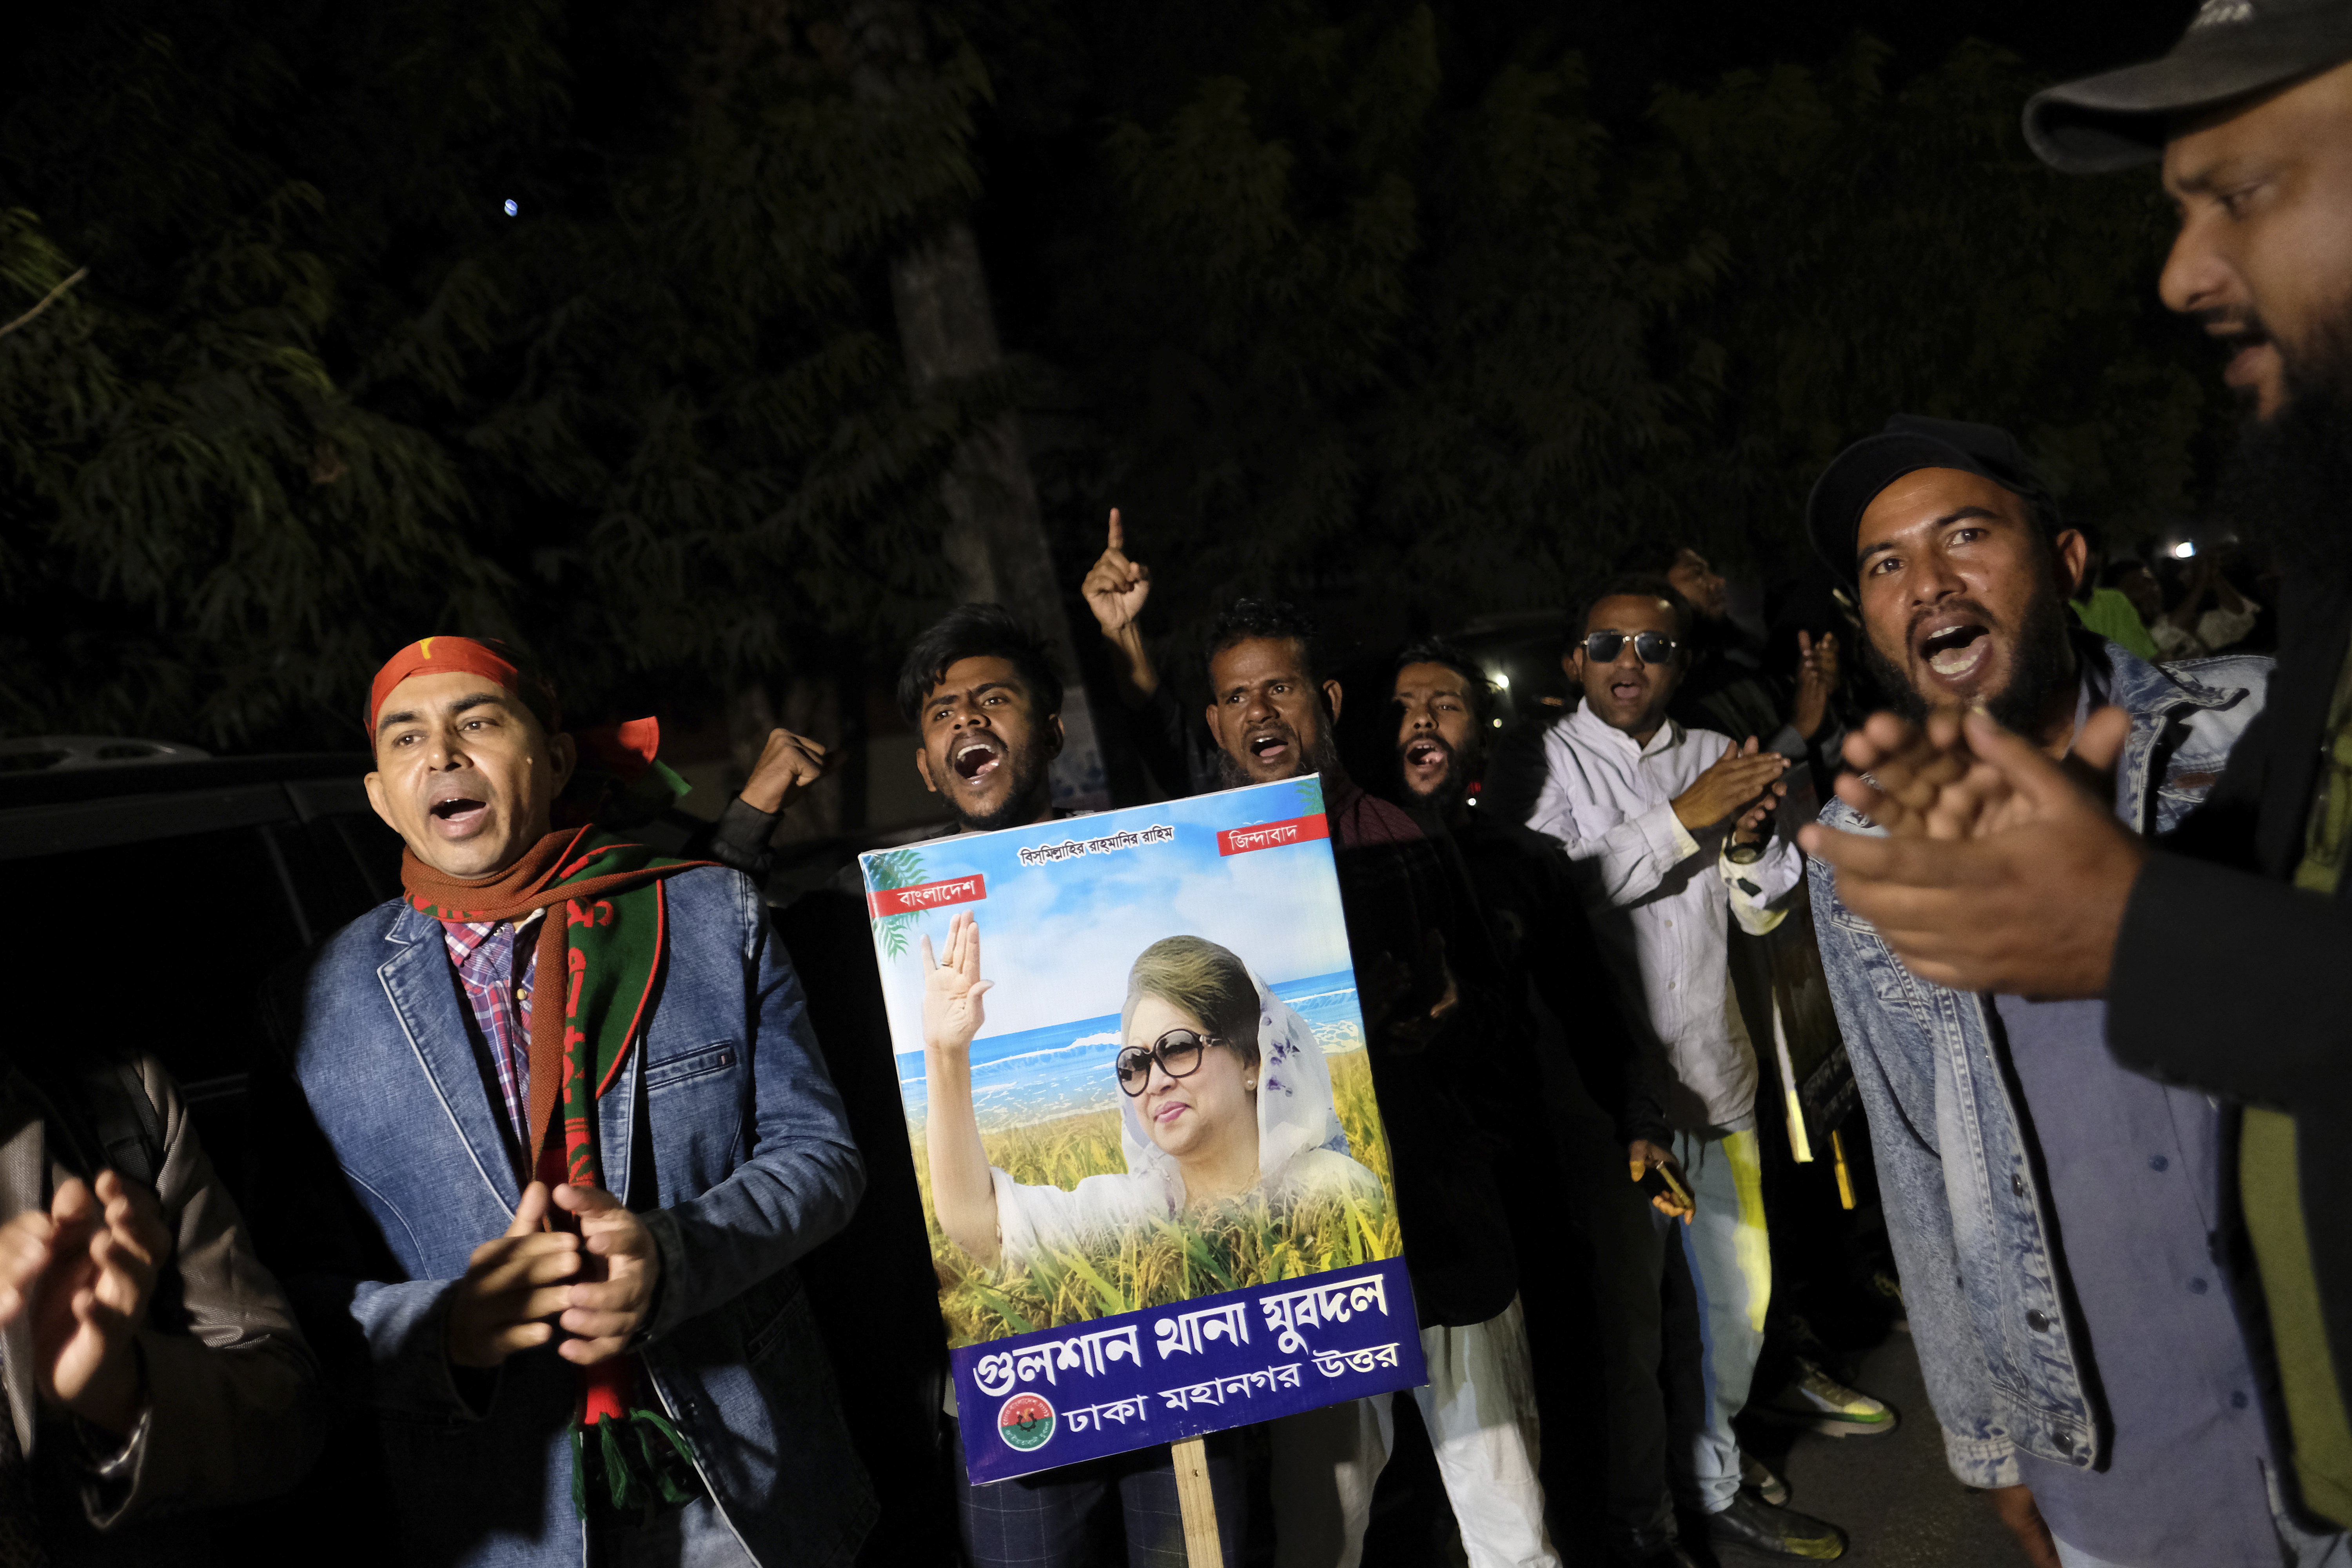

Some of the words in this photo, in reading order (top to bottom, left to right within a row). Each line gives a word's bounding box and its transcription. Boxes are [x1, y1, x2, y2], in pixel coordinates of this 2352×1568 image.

[1140, 826, 1173, 842] রাহিম
[1227, 825, 1298, 851] জিন্দাবাদ
[897, 880, 976, 907] বাংলাদেশ
[973, 1325, 1143, 1396] গুলশান
[1154, 1302, 1250, 1360] থানা
[1259, 1273, 1389, 1355] যুবদল
[1061, 1394, 1149, 1433] ঢাকা
[1157, 1363, 1303, 1411] মহানগর
[1311, 1342, 1401, 1377] উত্তর
